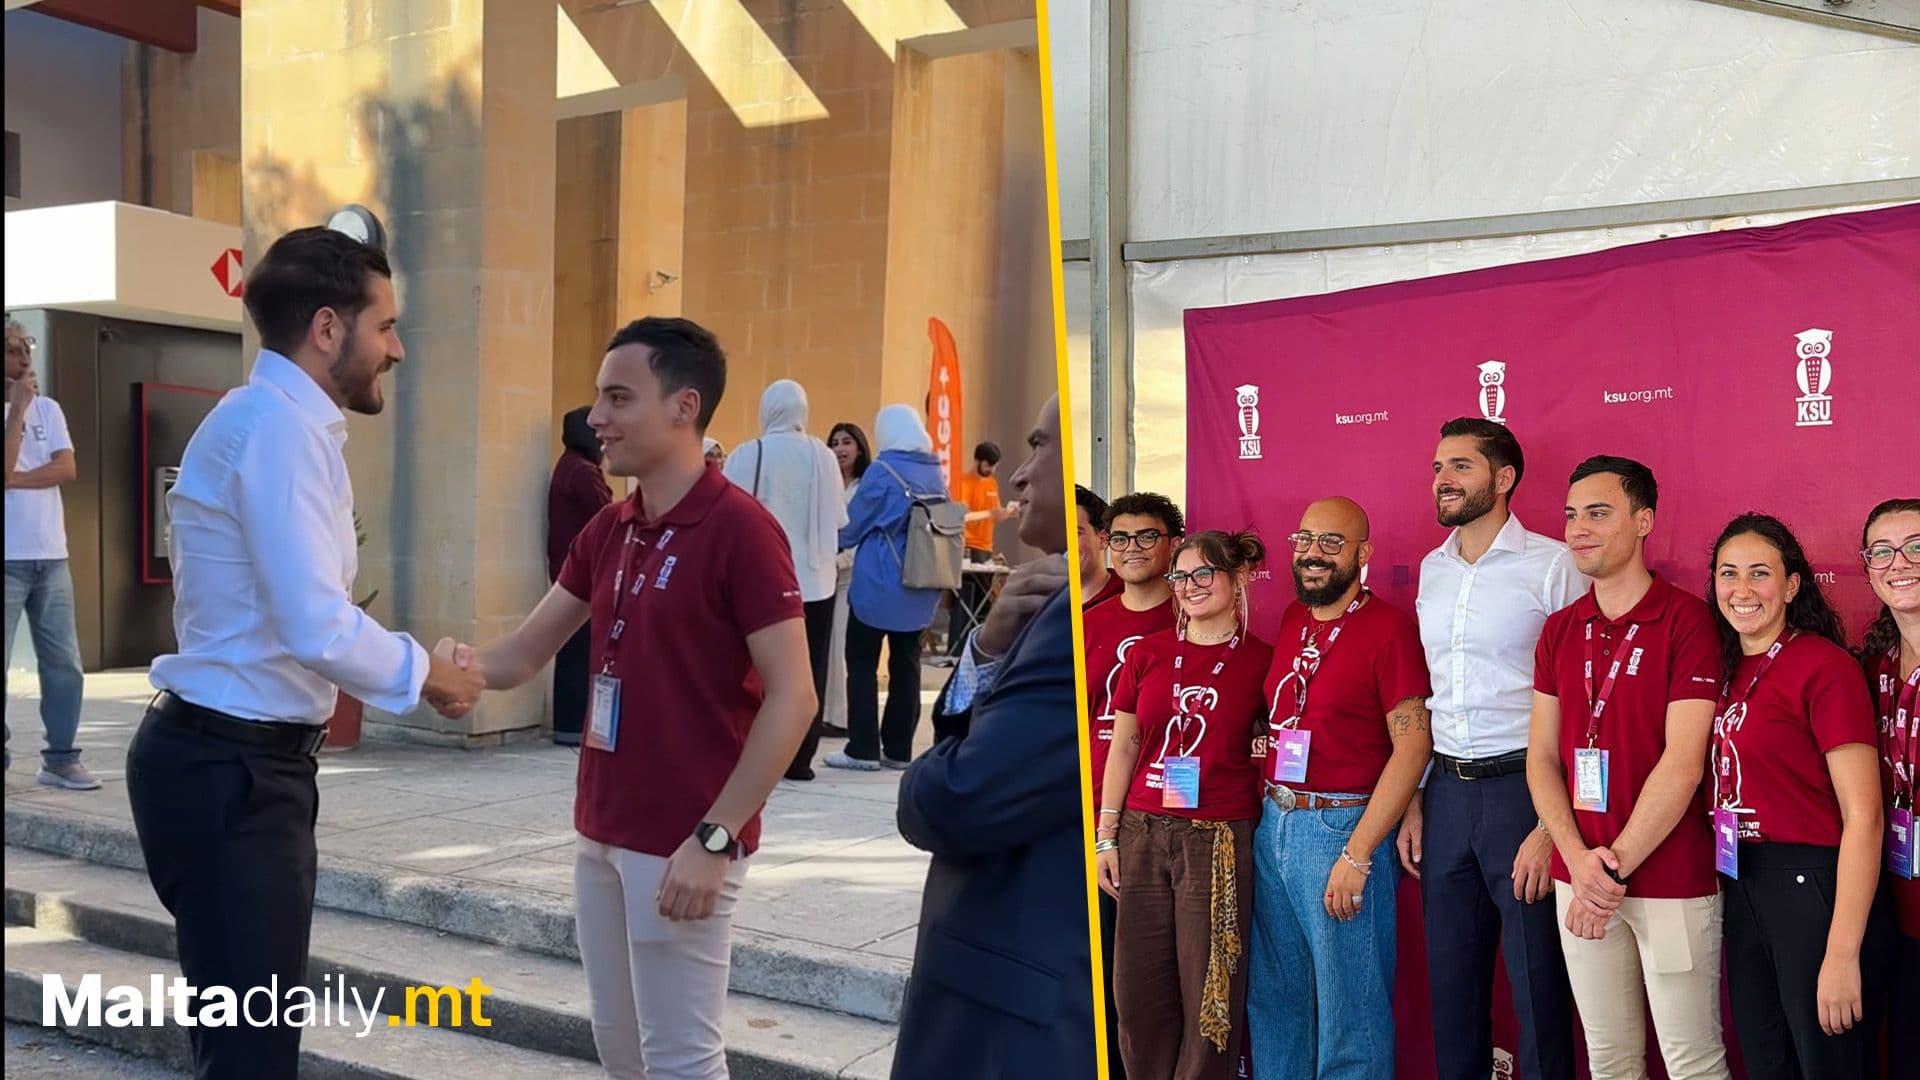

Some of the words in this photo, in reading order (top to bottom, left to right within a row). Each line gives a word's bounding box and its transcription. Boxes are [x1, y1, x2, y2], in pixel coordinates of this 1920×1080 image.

[1604, 386, 1673, 403] ksu.org.mt
[1335, 410, 1389, 425] ksu.org.mt
[1797, 401, 1830, 421] KSU
[1240, 439, 1260, 456] KSU
[1814, 570, 1836, 583] mt
